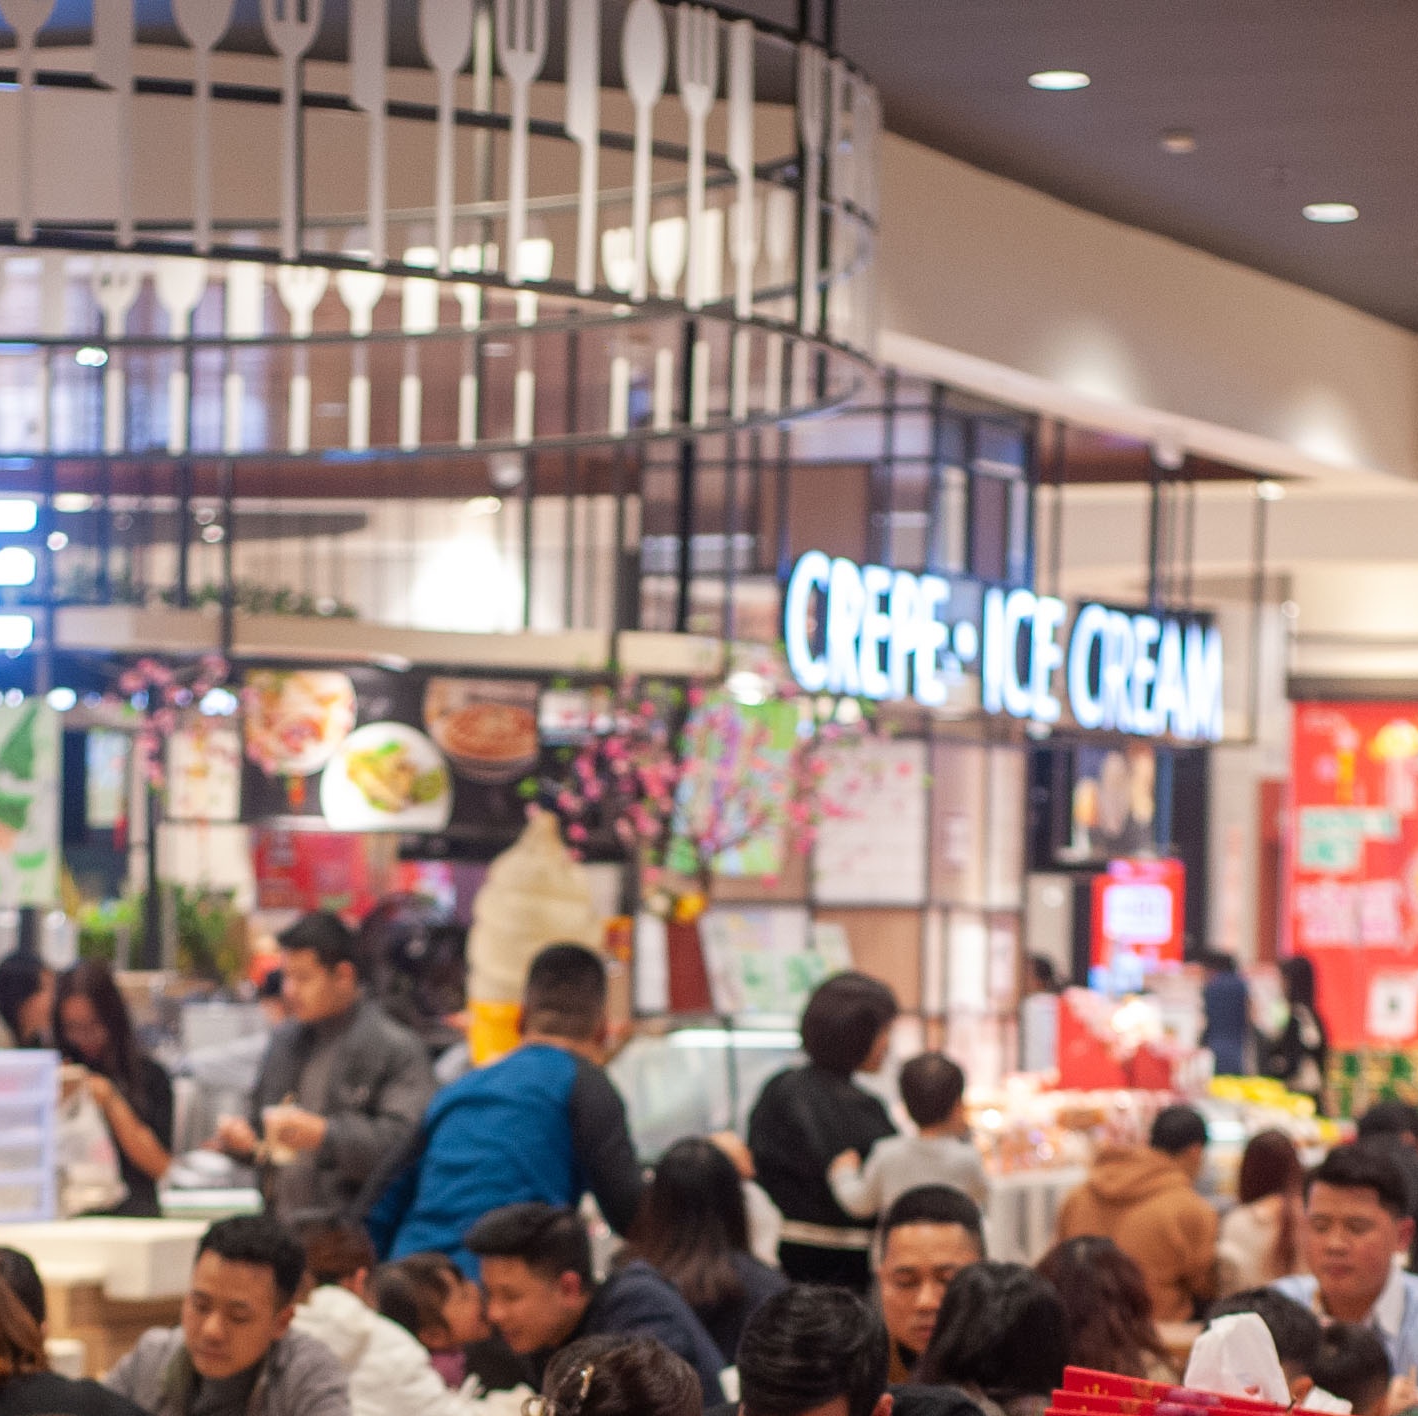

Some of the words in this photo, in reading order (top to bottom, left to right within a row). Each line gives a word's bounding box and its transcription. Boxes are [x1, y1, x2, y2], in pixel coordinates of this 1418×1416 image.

[785, 551, 951, 706] CREPE
[983, 588, 1066, 723] ICE
[1068, 603, 1224, 741] CREAM
